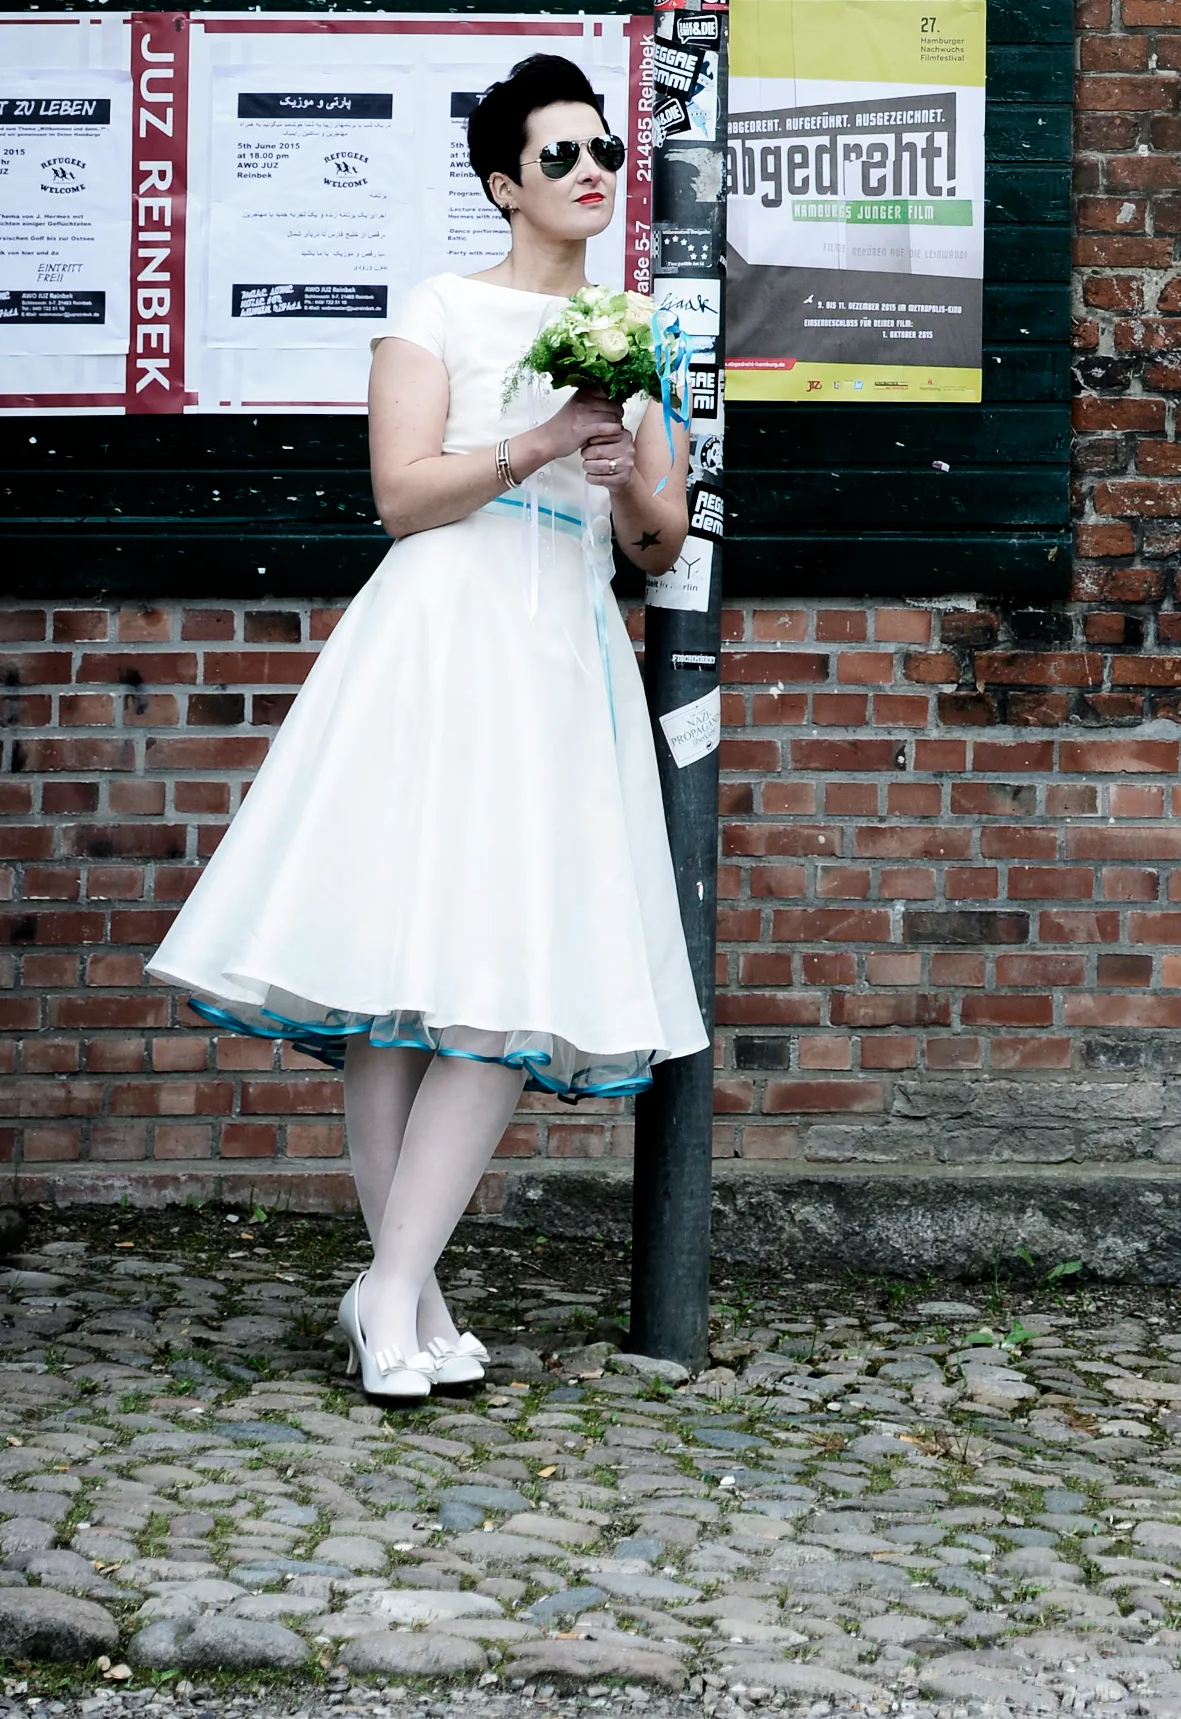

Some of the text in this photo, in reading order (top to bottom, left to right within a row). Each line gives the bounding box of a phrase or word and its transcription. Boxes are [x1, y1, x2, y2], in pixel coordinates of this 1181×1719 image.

[920, 17, 940, 33] 27.
[920, 37, 965, 47] Hamburger
[920, 45, 965, 54] Nachwuchs
[920, 53, 965, 62] Filmfestival
[638, 33, 655, 113] Reinbek
[13, 100, 35, 116] ZU
[38, 100, 97, 116] LEBEN
[279, 95, 352, 111] پارتی و موزیک
[727, 108, 946, 134] ABGEDREHT. AUFGEFÜHRT. AUSGEZEICHNET.
[237, 142, 300, 150] 5th June 2015
[450, 141, 465, 149] 5th
[636, 117, 653, 182] 21465
[3, 148, 26, 156] 2015
[323, 151, 369, 164] REFUGEES
[40, 157, 87, 170] REFUGEES
[727, 131, 957, 209] abgedreht!
[237, 171, 272, 179] Reinbek
[40, 183, 87, 195] WELCOME
[323, 177, 368, 188] WELCOME
[448, 190, 482, 198] Program:
[135, 32, 175, 394] JUZ REINBEK
[794, 203, 934, 220] HAMBURGS JUNGER FILM
[634, 221, 651, 252] 5-7
[823, 242, 968, 260] FILME GEHÖREN AUF DIE LEINWAND!
[37, 263, 83, 272] EINTRITT
[817, 301, 825, 309] 9.
[826, 301, 837, 309] BIS
[838, 301, 846, 310] 11.
[848, 302, 880, 311] DEZEMBER
[881, 303, 896, 311] 2015
[908, 304, 963, 314] METROPOLIS-KINO
[860, 316, 872, 327] FÜR
[896, 319, 913, 328] FILM:
[890, 331, 916, 339] OKTOBER
[918, 331, 933, 339] 2015
